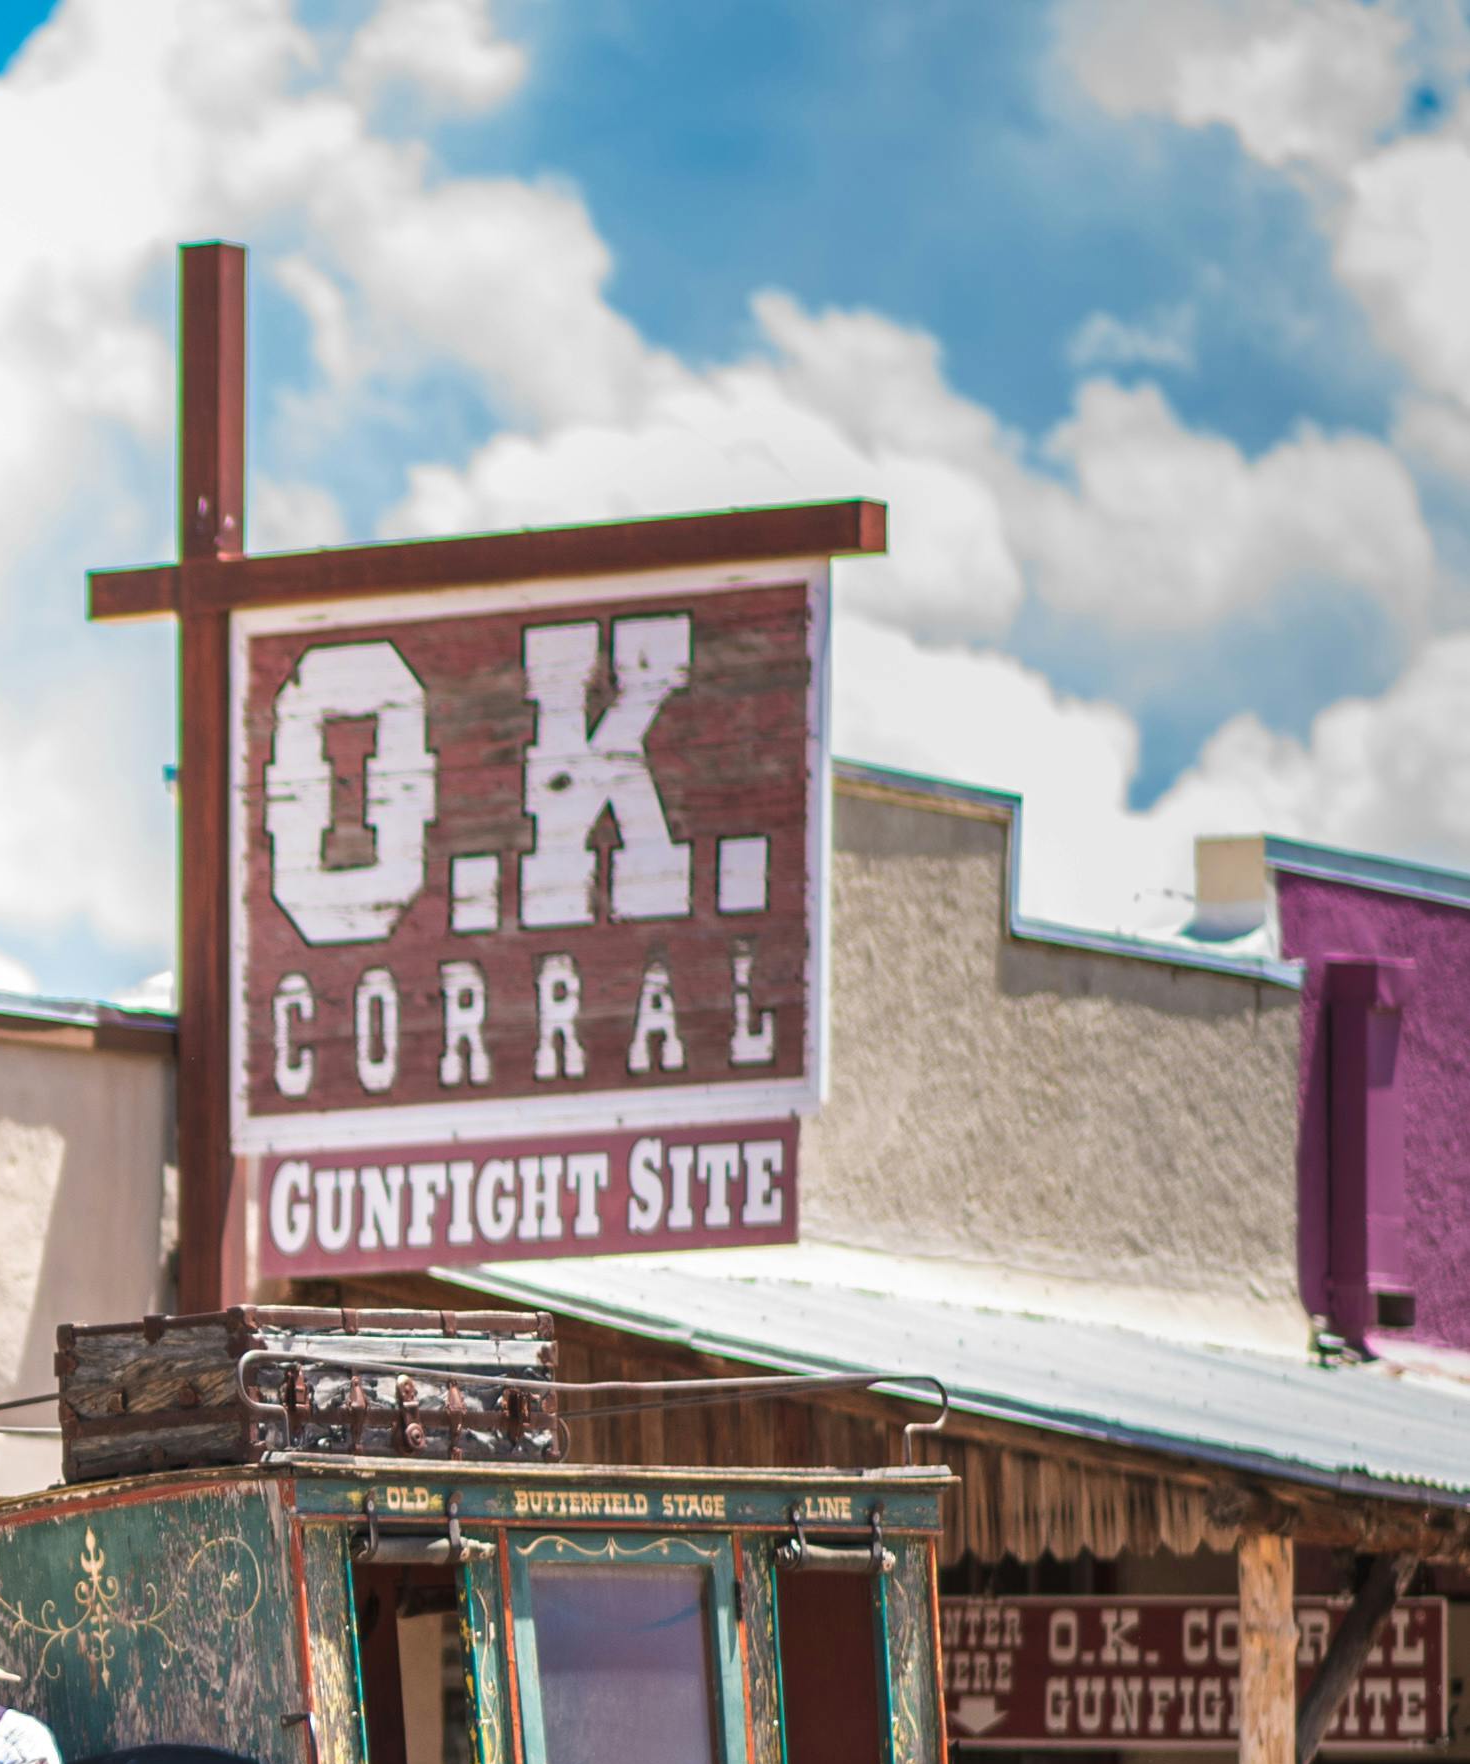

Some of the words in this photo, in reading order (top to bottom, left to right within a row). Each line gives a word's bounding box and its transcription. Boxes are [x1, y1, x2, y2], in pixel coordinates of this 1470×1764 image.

[272, 940, 777, 1098] CORRAL
[269, 1150, 611, 1256] GUNFIGHT
[626, 1136, 787, 1236] SITE
[386, 1486, 430, 1511] OLD
[514, 1490, 649, 1516] BUTTERFIELD
[661, 1494, 727, 1520] STAGE
[804, 1496, 852, 1520] LINE
[943, 1605, 1023, 1648] NTER
[1182, 1608, 1427, 1666] CORL
